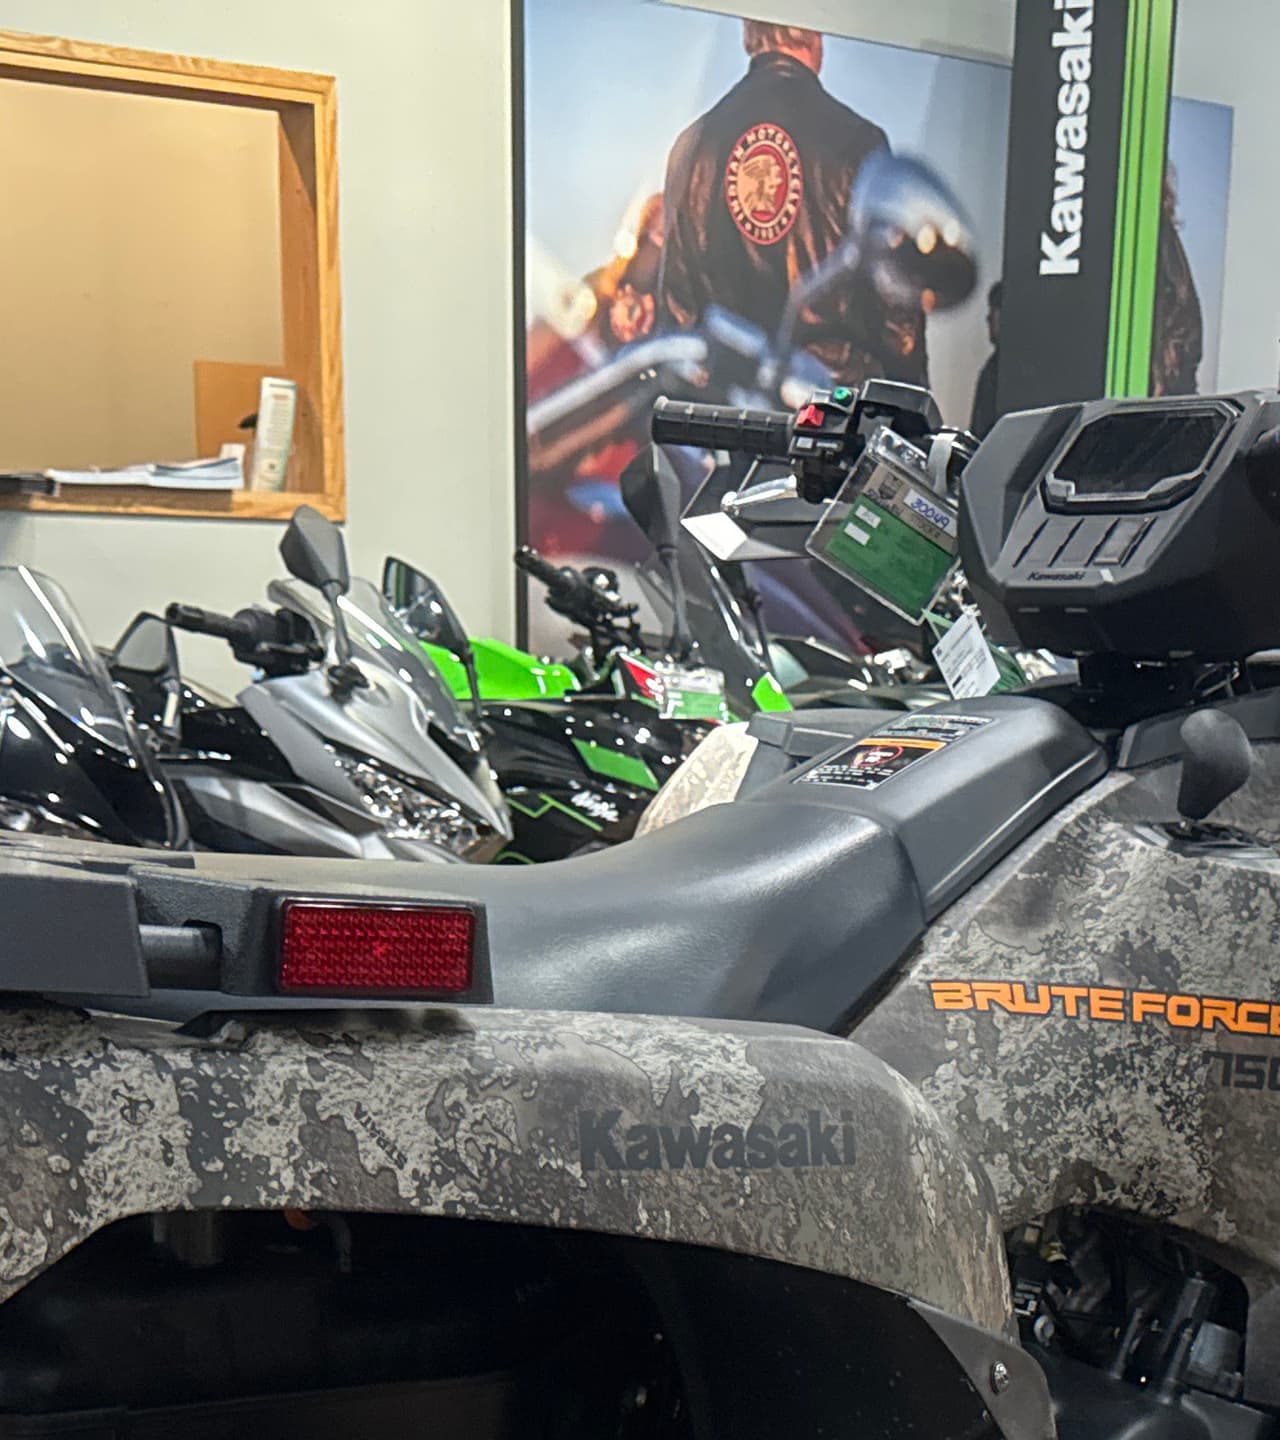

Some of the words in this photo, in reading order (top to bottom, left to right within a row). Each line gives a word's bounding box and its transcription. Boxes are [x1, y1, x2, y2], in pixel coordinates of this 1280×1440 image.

[1039, 0, 1095, 275] Kawasaki
[930, 982, 1125, 1022] BRUTE
[578, 1109, 857, 1171] Kawasaki
